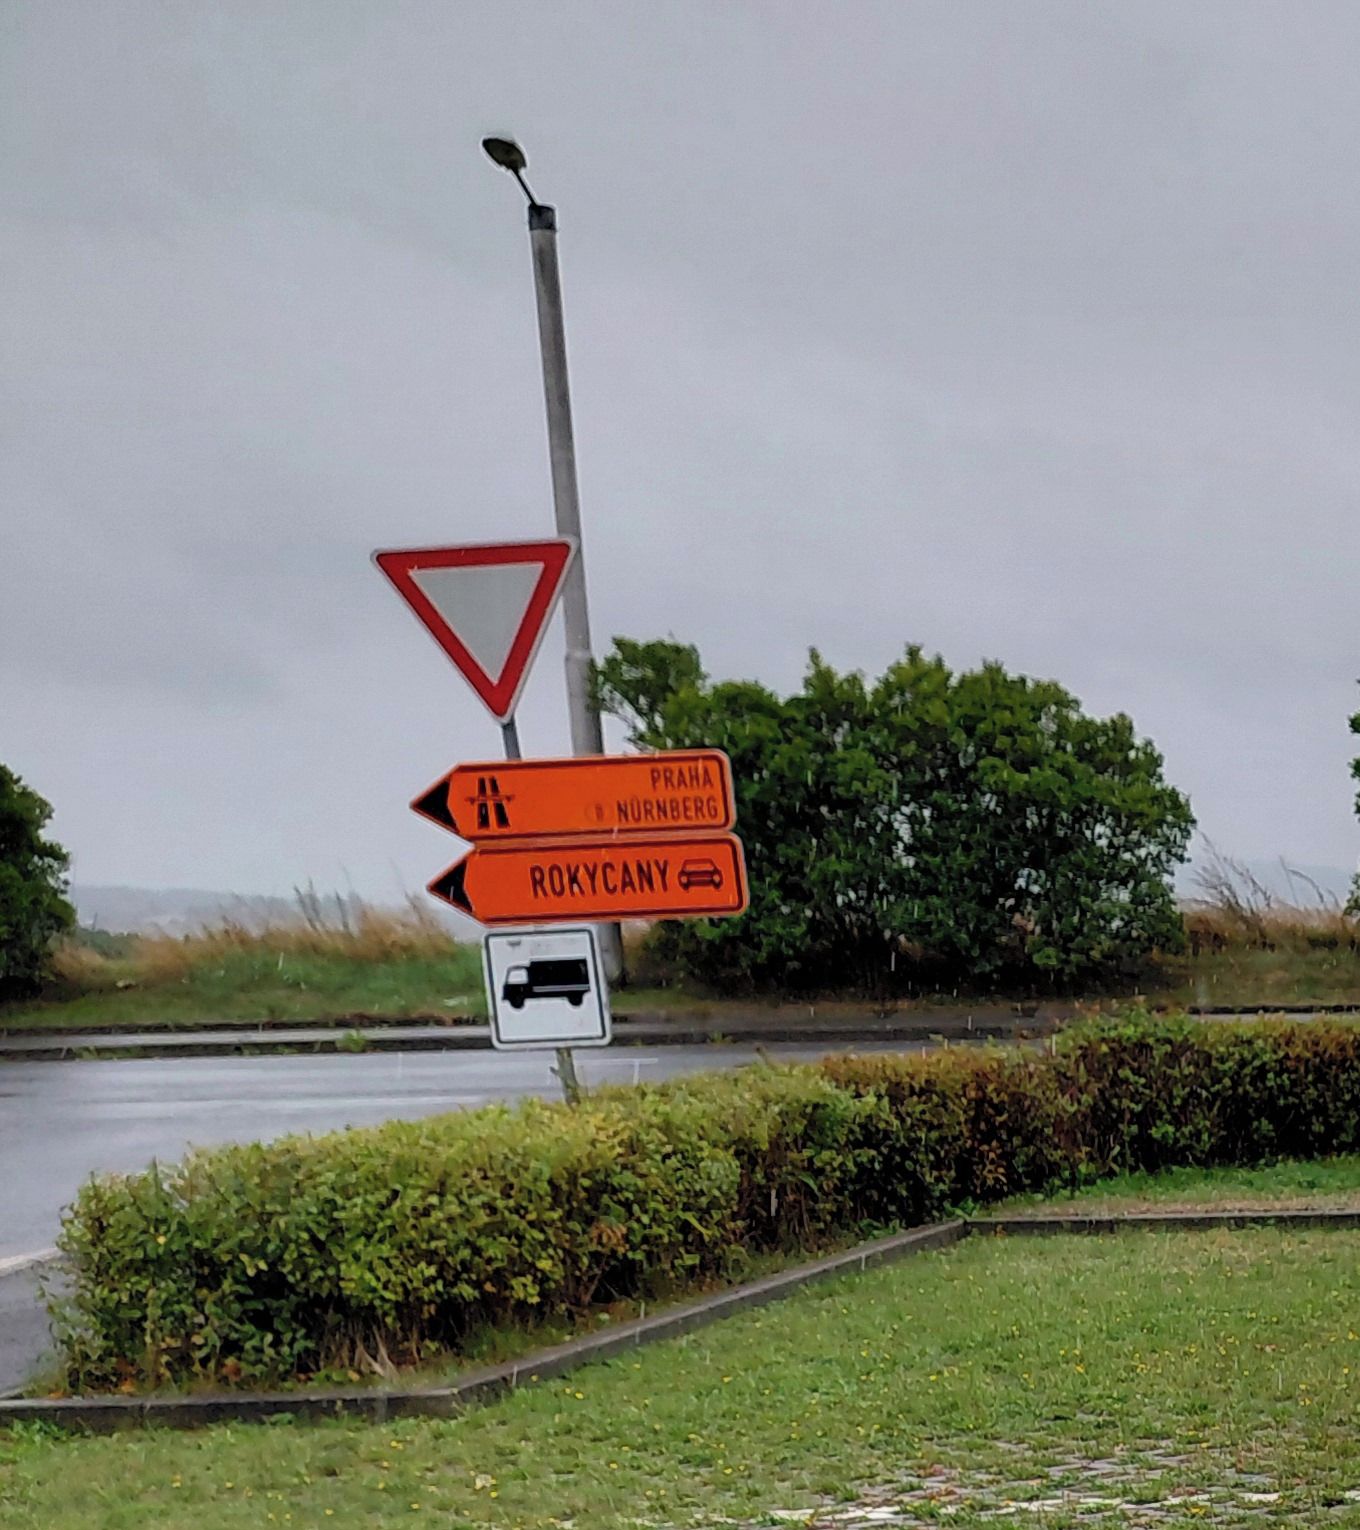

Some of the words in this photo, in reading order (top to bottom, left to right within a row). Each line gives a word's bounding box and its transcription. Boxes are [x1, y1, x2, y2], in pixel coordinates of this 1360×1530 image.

[650, 765, 714, 791] PRAHA
[616, 794, 719, 823] NÜRNBERG
[529, 859, 669, 899] ROKYCANY
